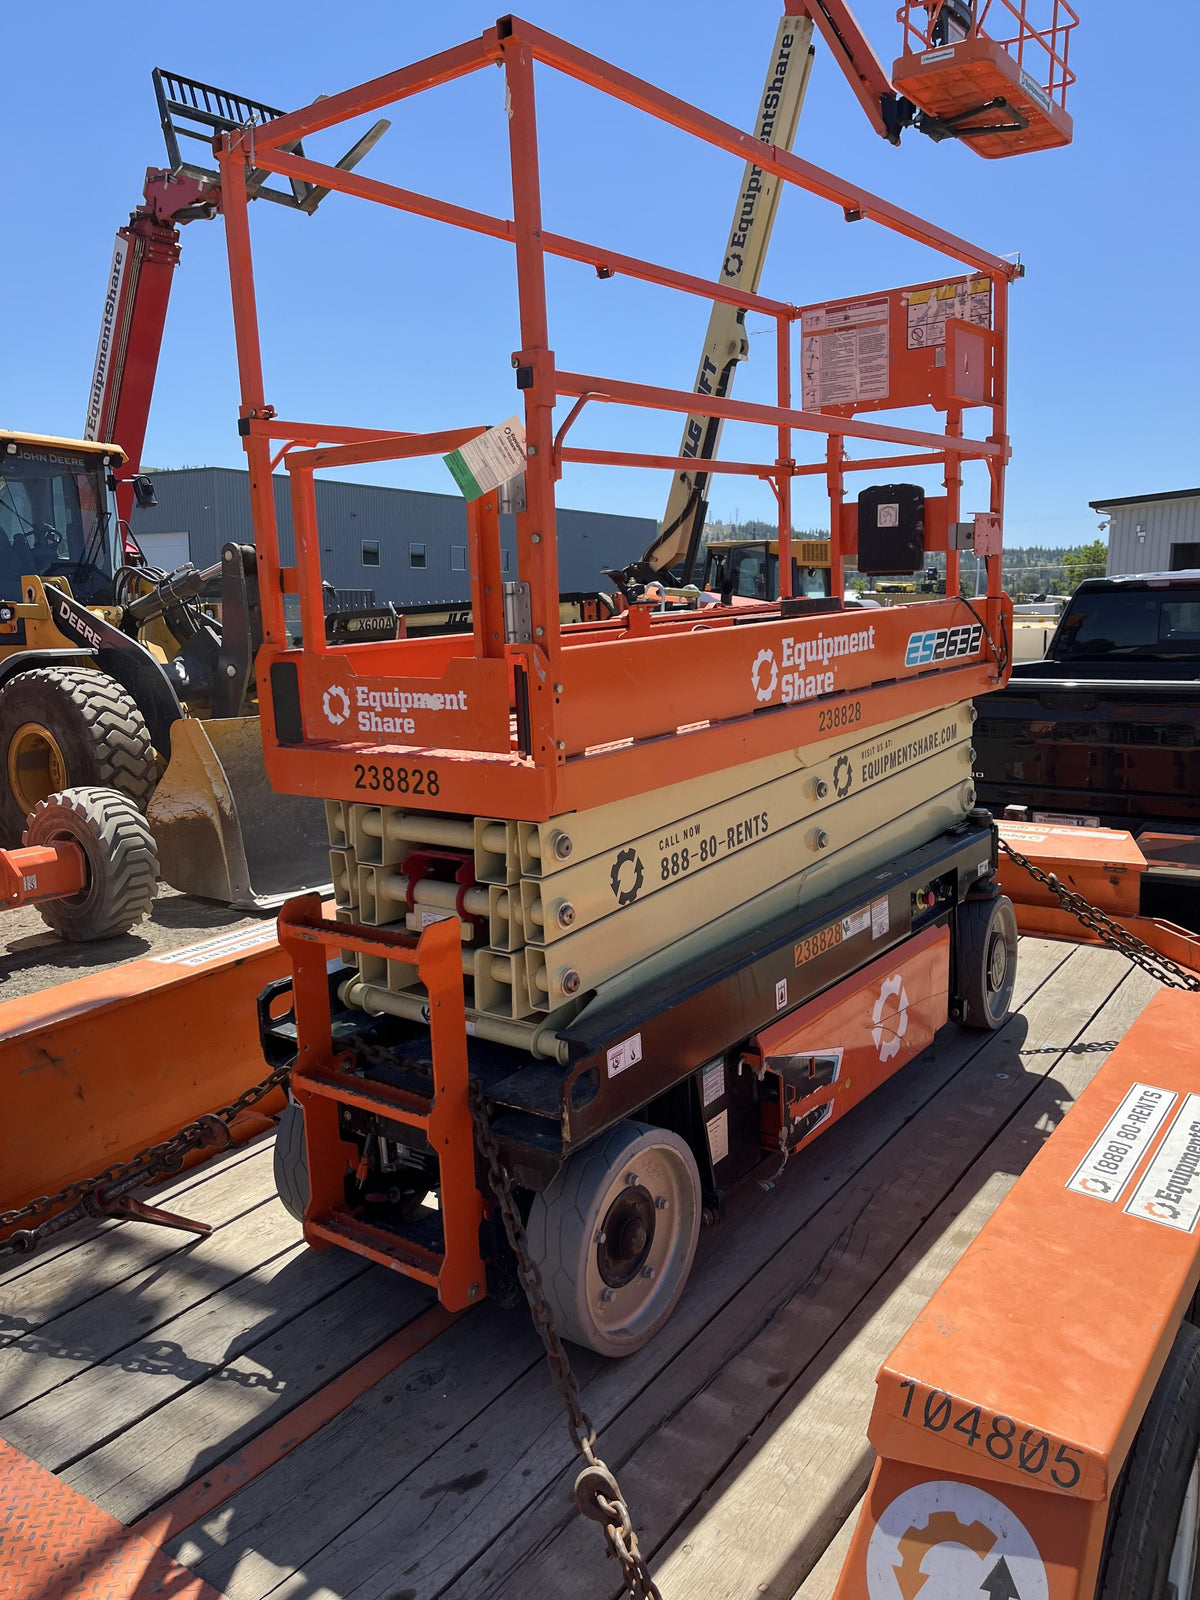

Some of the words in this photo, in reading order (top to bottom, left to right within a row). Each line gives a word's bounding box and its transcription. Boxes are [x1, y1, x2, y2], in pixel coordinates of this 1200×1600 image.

[87, 251, 123, 432] EquipmentShare
[17, 451, 47, 462] JOHN
[49, 454, 85, 466] DEERE
[60, 601, 102, 650] DEERE
[445, 612, 470, 625] JLG
[781, 625, 875, 670] Equipment
[905, 624, 983, 667] ES2632
[781, 672, 835, 703] Share
[357, 711, 416, 734] Share
[819, 702, 861, 732] 238828
[861, 749, 875, 760] VISIT
[877, 744, 885, 752] US
[862, 723, 957, 783] EQUIPMENTSHARE.COM
[354, 764, 440, 796] 238828
[659, 833, 680, 851] CALL
[683, 823, 701, 841] NOW
[661, 811, 769, 881] 888-80-RENTS
[795, 923, 841, 966] 238828
[1093, 1140, 1133, 1175] (888)
[1116, 1090, 1163, 1141] 80-RENTS
[900, 1379, 1085, 1489] 104805
